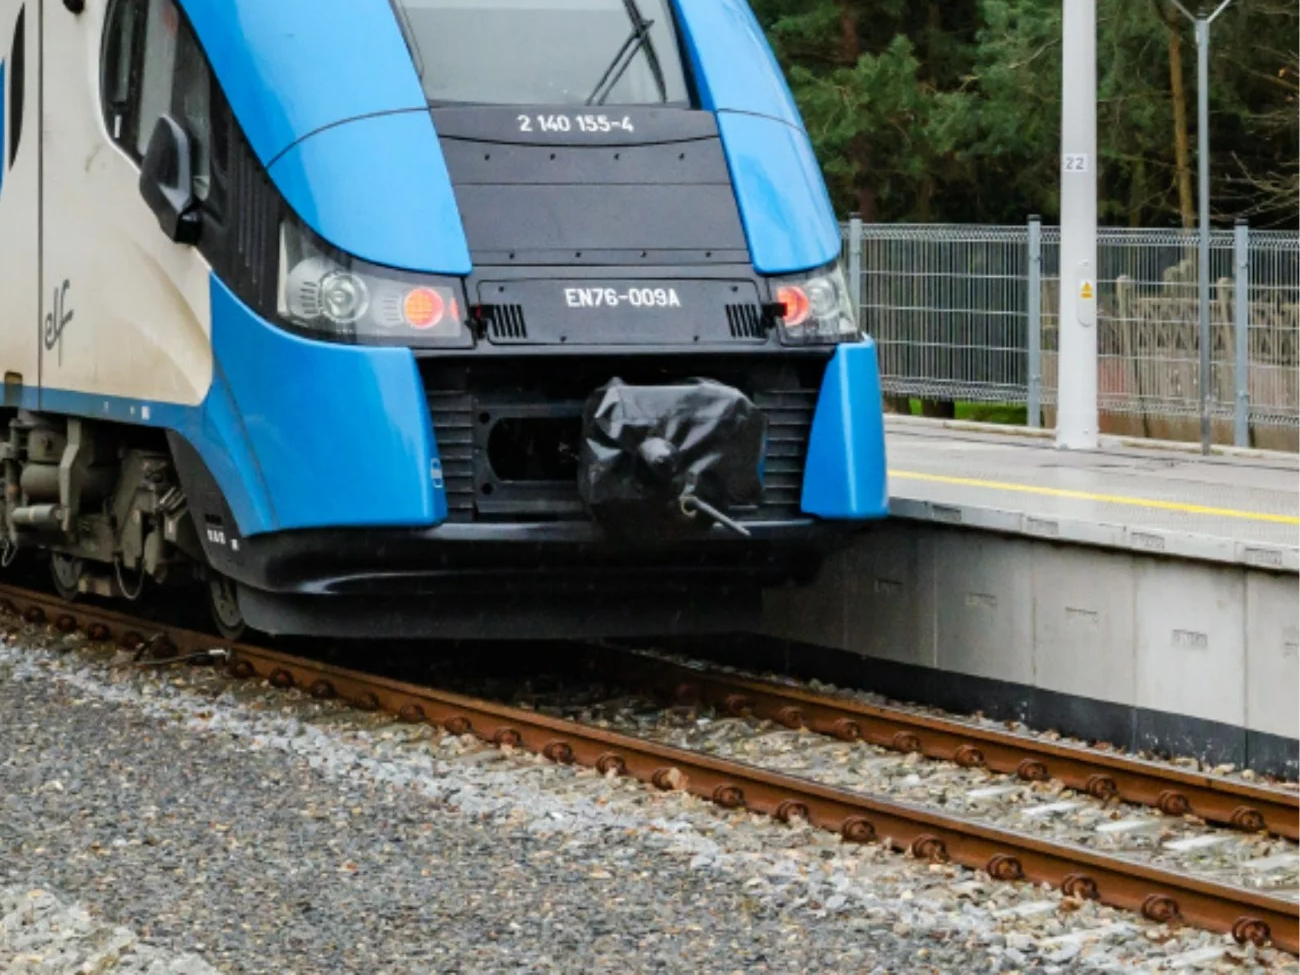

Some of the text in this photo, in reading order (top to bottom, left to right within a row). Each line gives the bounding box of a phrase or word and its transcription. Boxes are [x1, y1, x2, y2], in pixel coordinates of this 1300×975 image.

[518, 115, 634, 132] 2 140 155-4
[1066, 157, 1085, 170] 22
[565, 289, 680, 307] EN76-009A
[45, 279, 74, 367] elf
